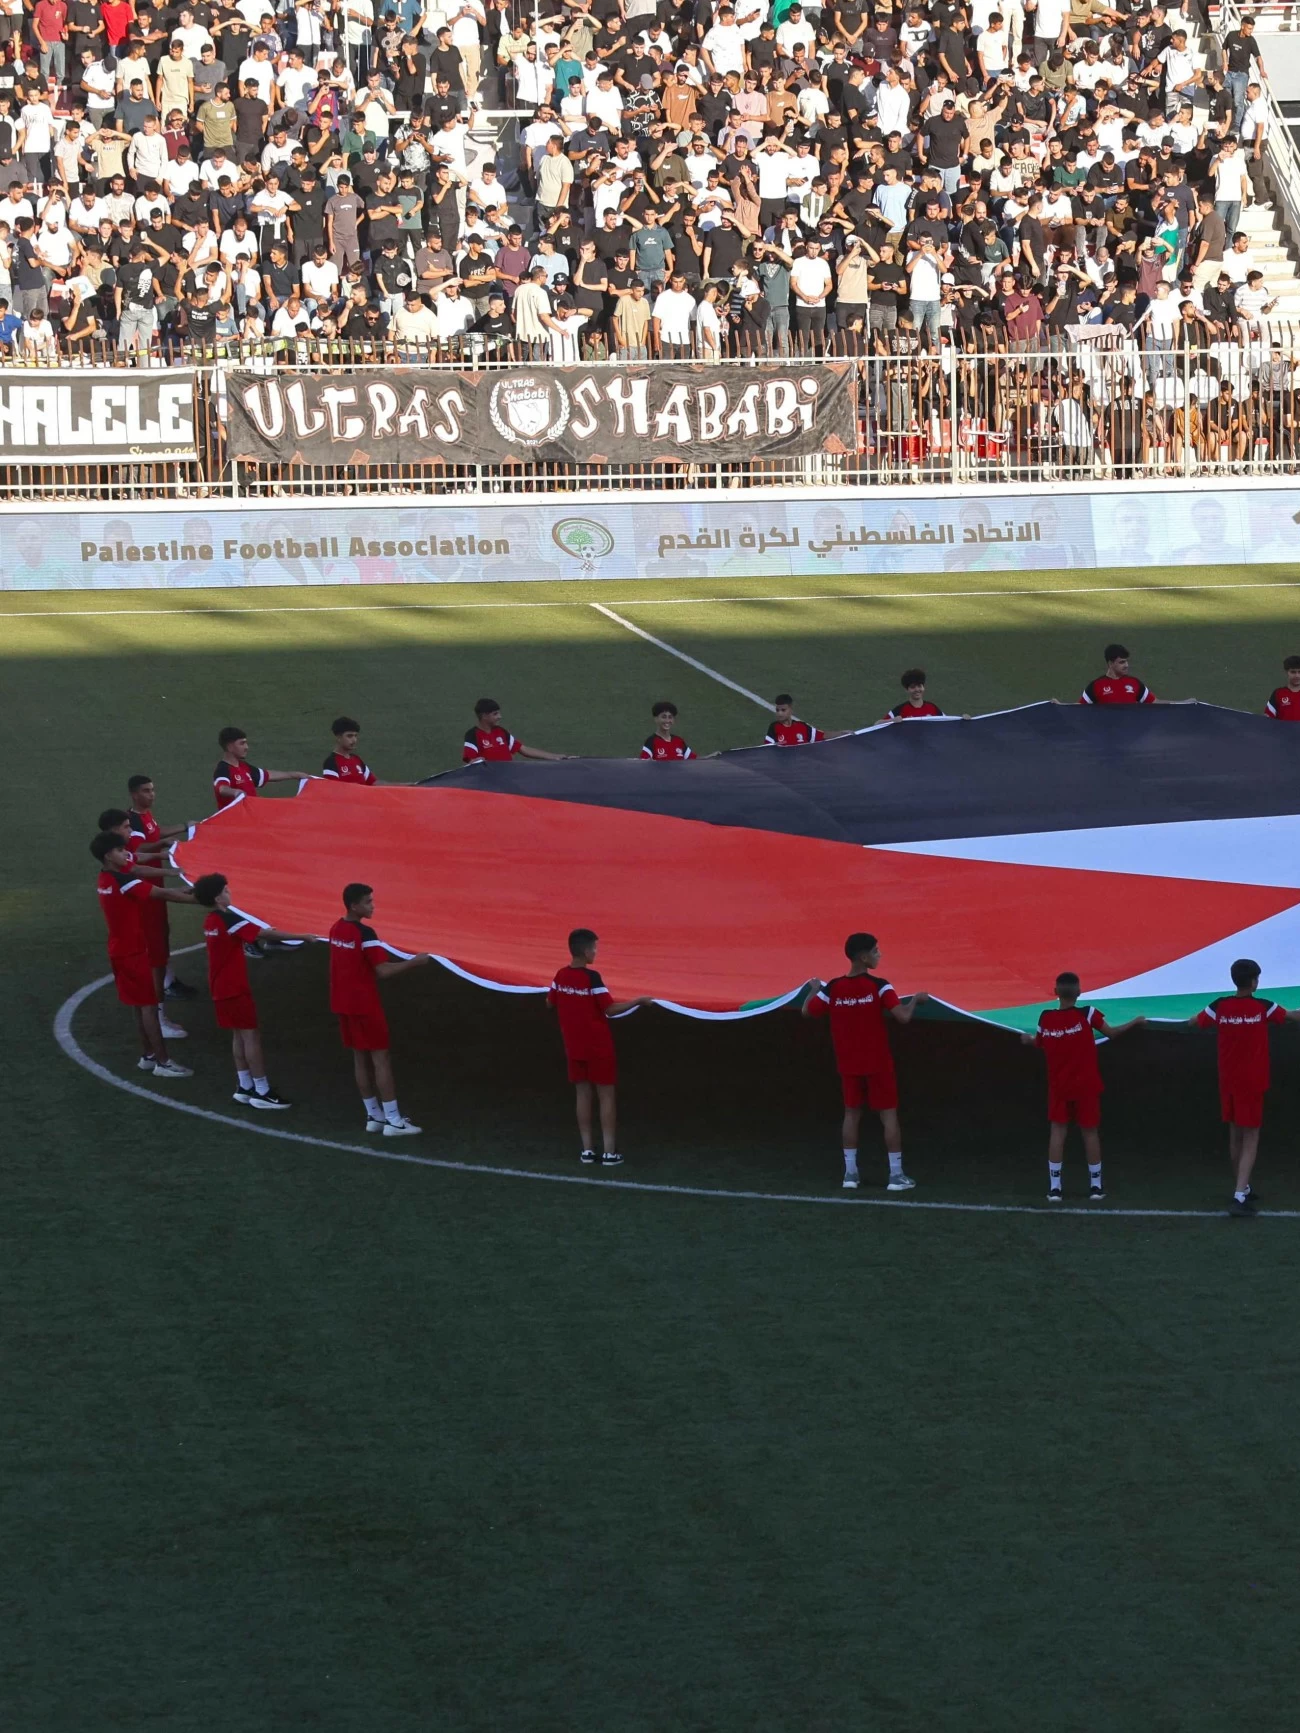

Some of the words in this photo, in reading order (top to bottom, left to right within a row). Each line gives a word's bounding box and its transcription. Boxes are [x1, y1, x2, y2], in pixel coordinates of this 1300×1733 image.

[501, 378, 535, 389] ULTRAS
[242, 379, 466, 442] ULTRAS
[658, 527, 730, 559] القدم
[739, 527, 800, 554] لكرة
[808, 524, 954, 558] الفلسطيني
[963, 521, 1041, 544] الاتحاد
[81, 540, 213, 562] Palestine
[223, 537, 339, 560] Football
[349, 535, 510, 558] Association
